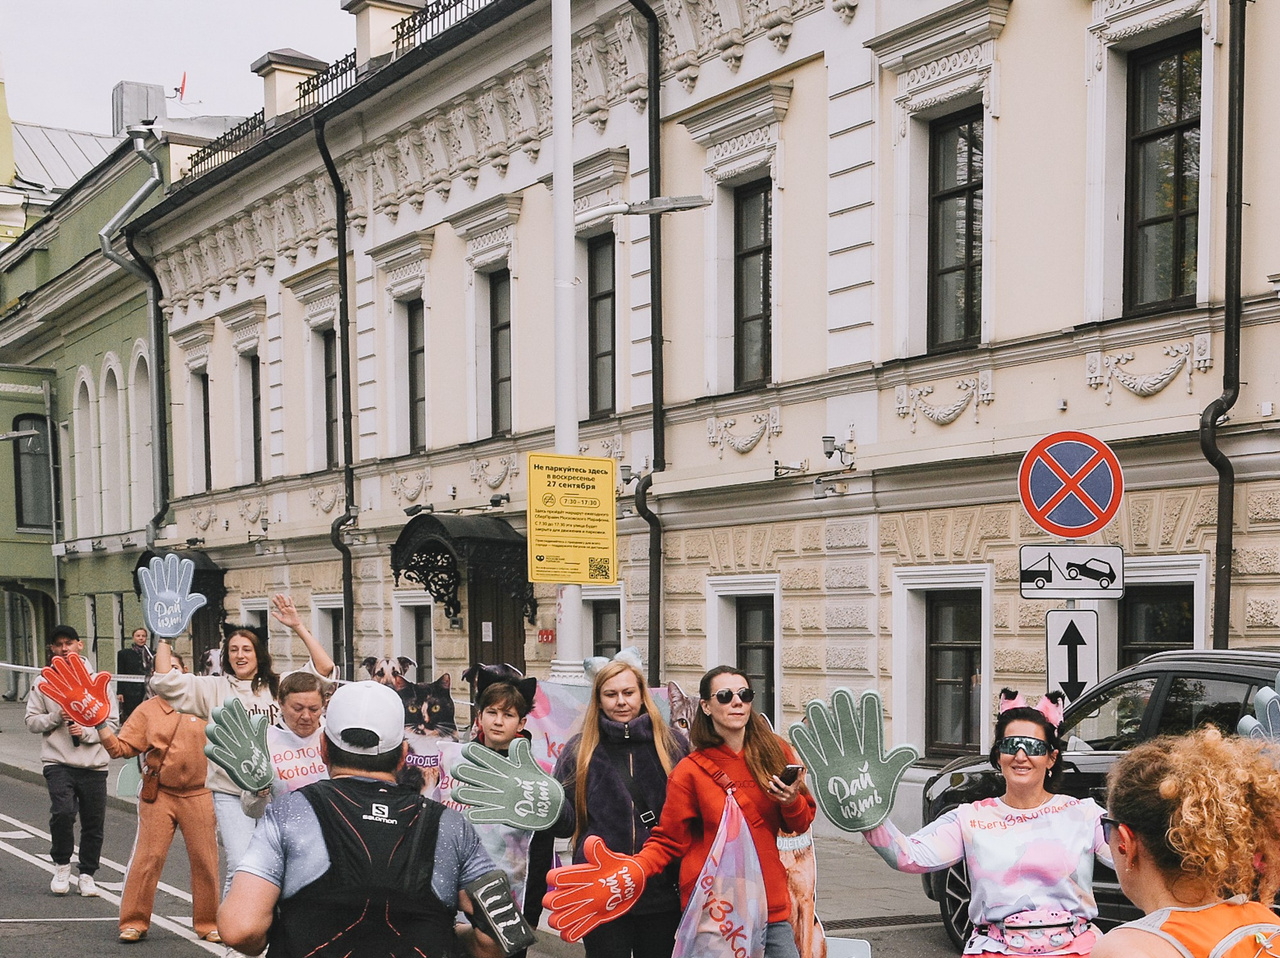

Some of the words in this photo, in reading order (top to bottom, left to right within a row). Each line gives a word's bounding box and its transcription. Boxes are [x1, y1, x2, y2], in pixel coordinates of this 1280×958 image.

[545, 466, 587, 475] паркуйтесь
[552, 474, 596, 482] воскресенье
[558, 482, 596, 490] сентября
[154, 597, 181, 618] Дай
[70, 688, 96, 714] Дай
[241, 740, 262, 775] Дай
[277, 762, 326, 780] kotode
[828, 760, 875, 804] Дай
[514, 777, 535, 818] Дай
[536, 780, 552, 818] пять
[840, 790, 882, 818] пять
[598, 873, 623, 911] Дай
[618, 866, 636, 901] пять
